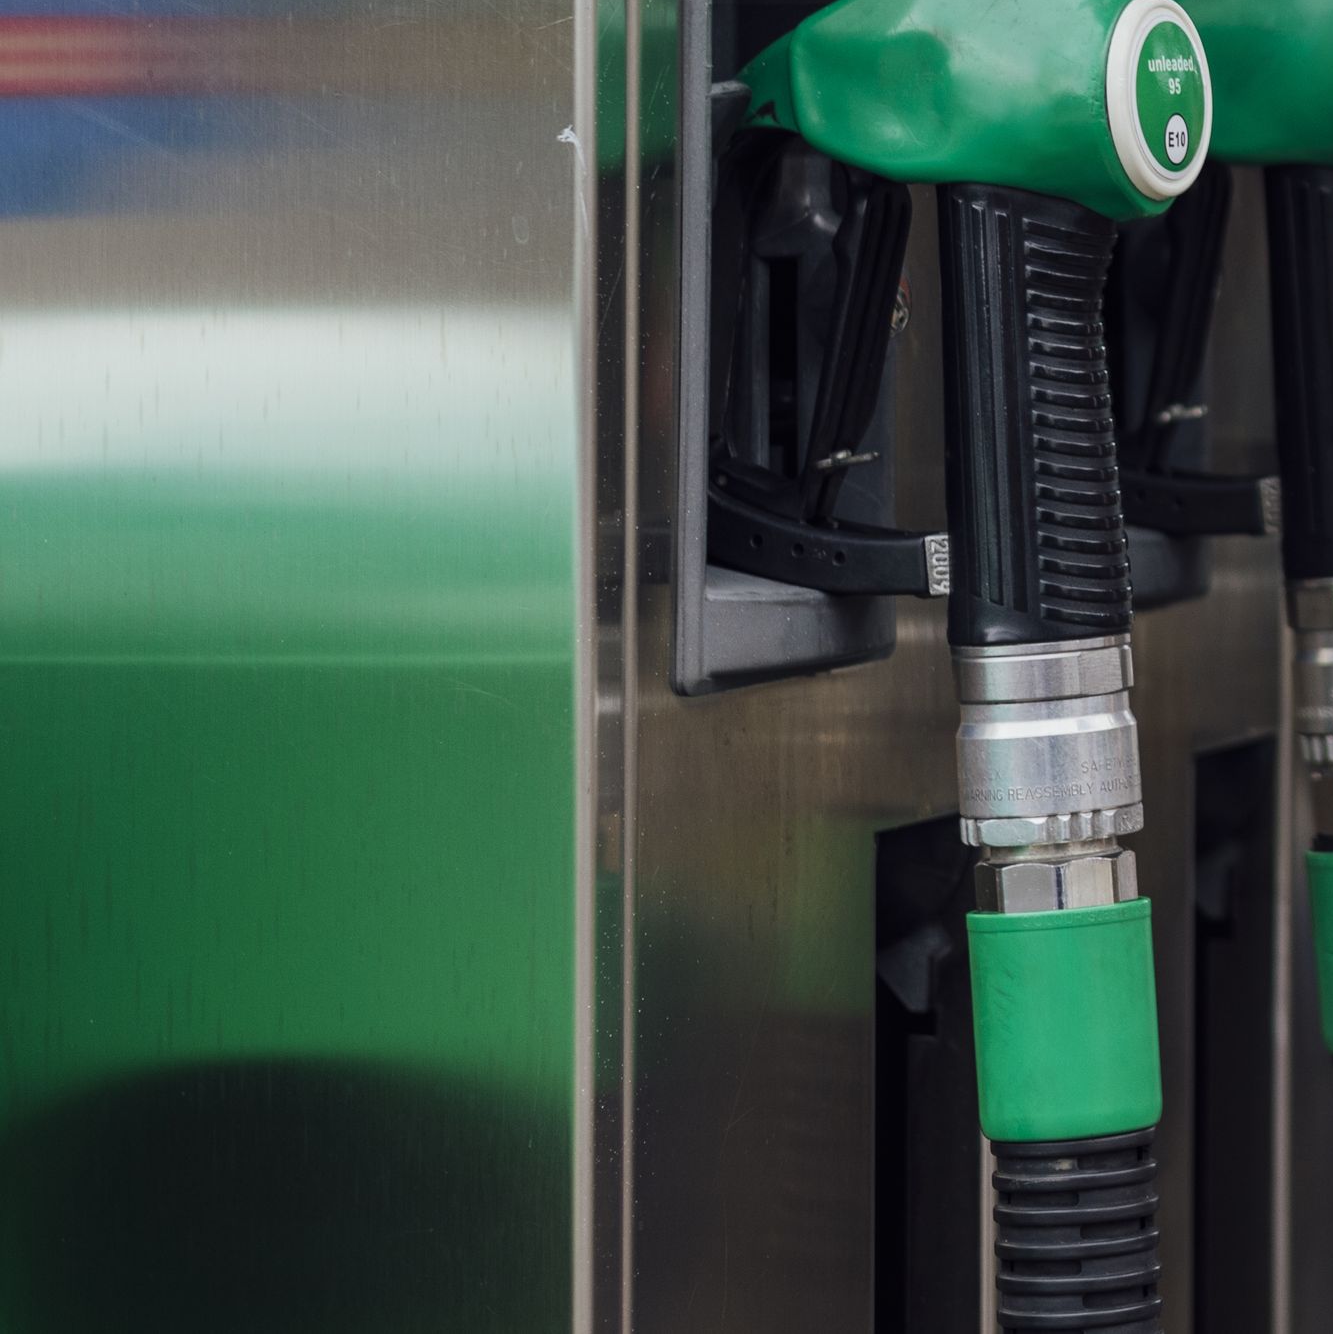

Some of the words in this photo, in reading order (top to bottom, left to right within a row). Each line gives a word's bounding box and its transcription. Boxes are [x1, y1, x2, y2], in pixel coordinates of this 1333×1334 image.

[1148, 55, 1194, 72] unleaded
[1168, 77, 1181, 94] 95
[1168, 131, 1185, 147] E10
[1007, 781, 1093, 802] REASSEMBLY
